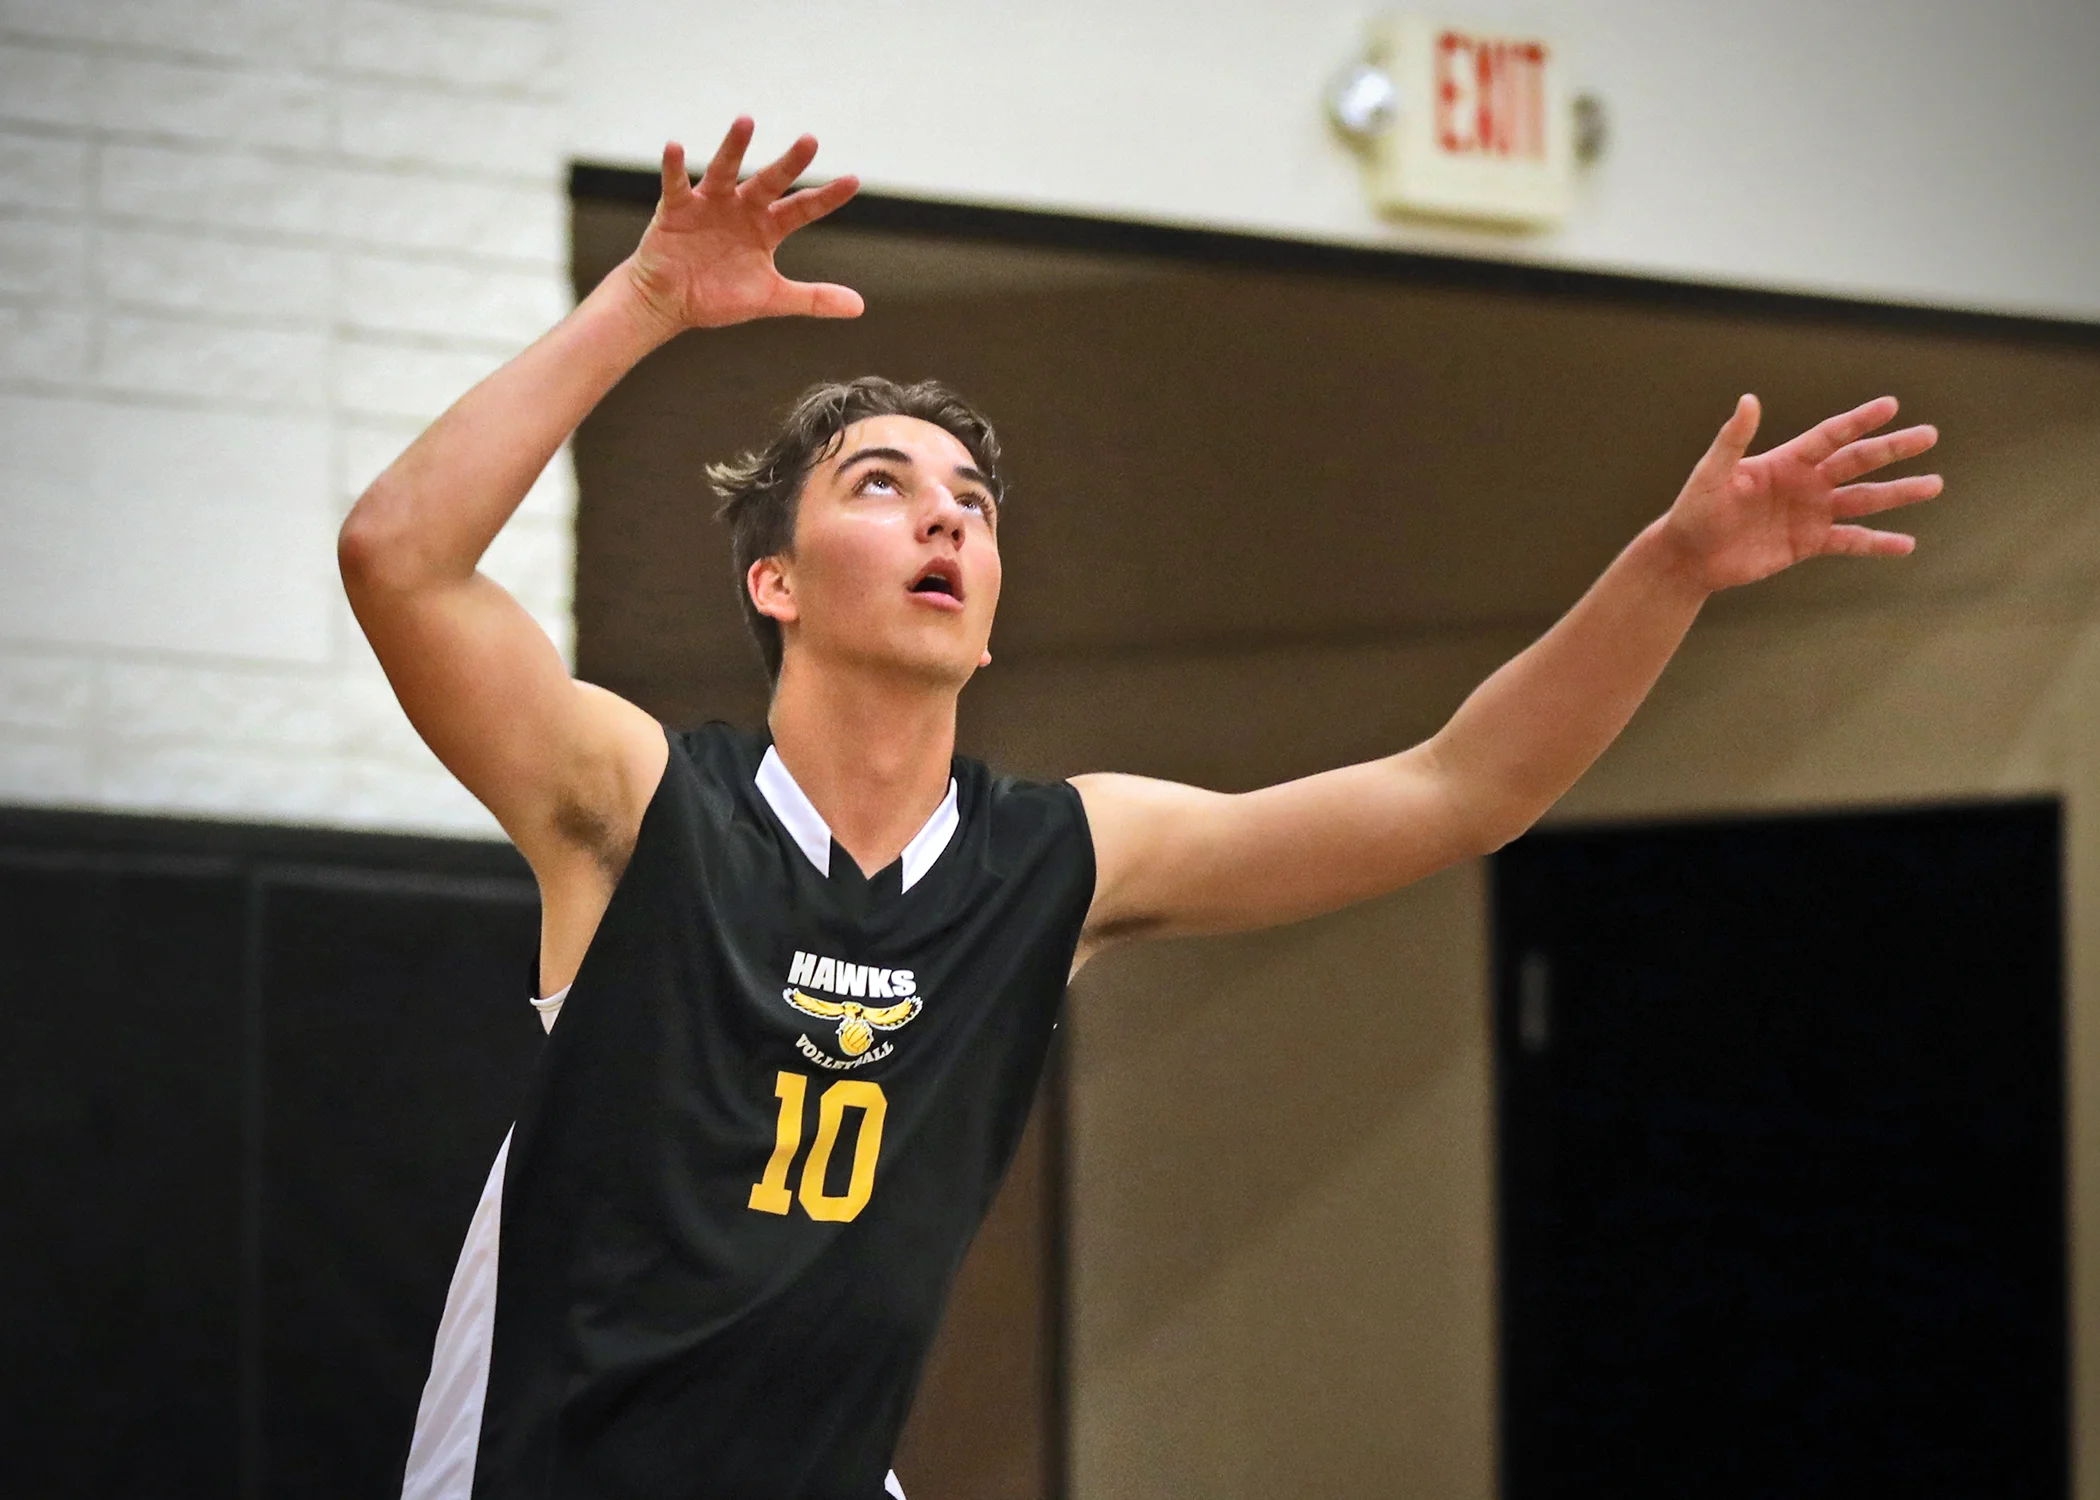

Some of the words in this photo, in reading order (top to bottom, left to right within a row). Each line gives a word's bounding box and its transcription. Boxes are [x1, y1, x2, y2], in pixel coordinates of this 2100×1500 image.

[1434, 32, 1547, 159] EXIT
[787, 950, 917, 998] HAWKS
[748, 1070, 888, 1223] 10
